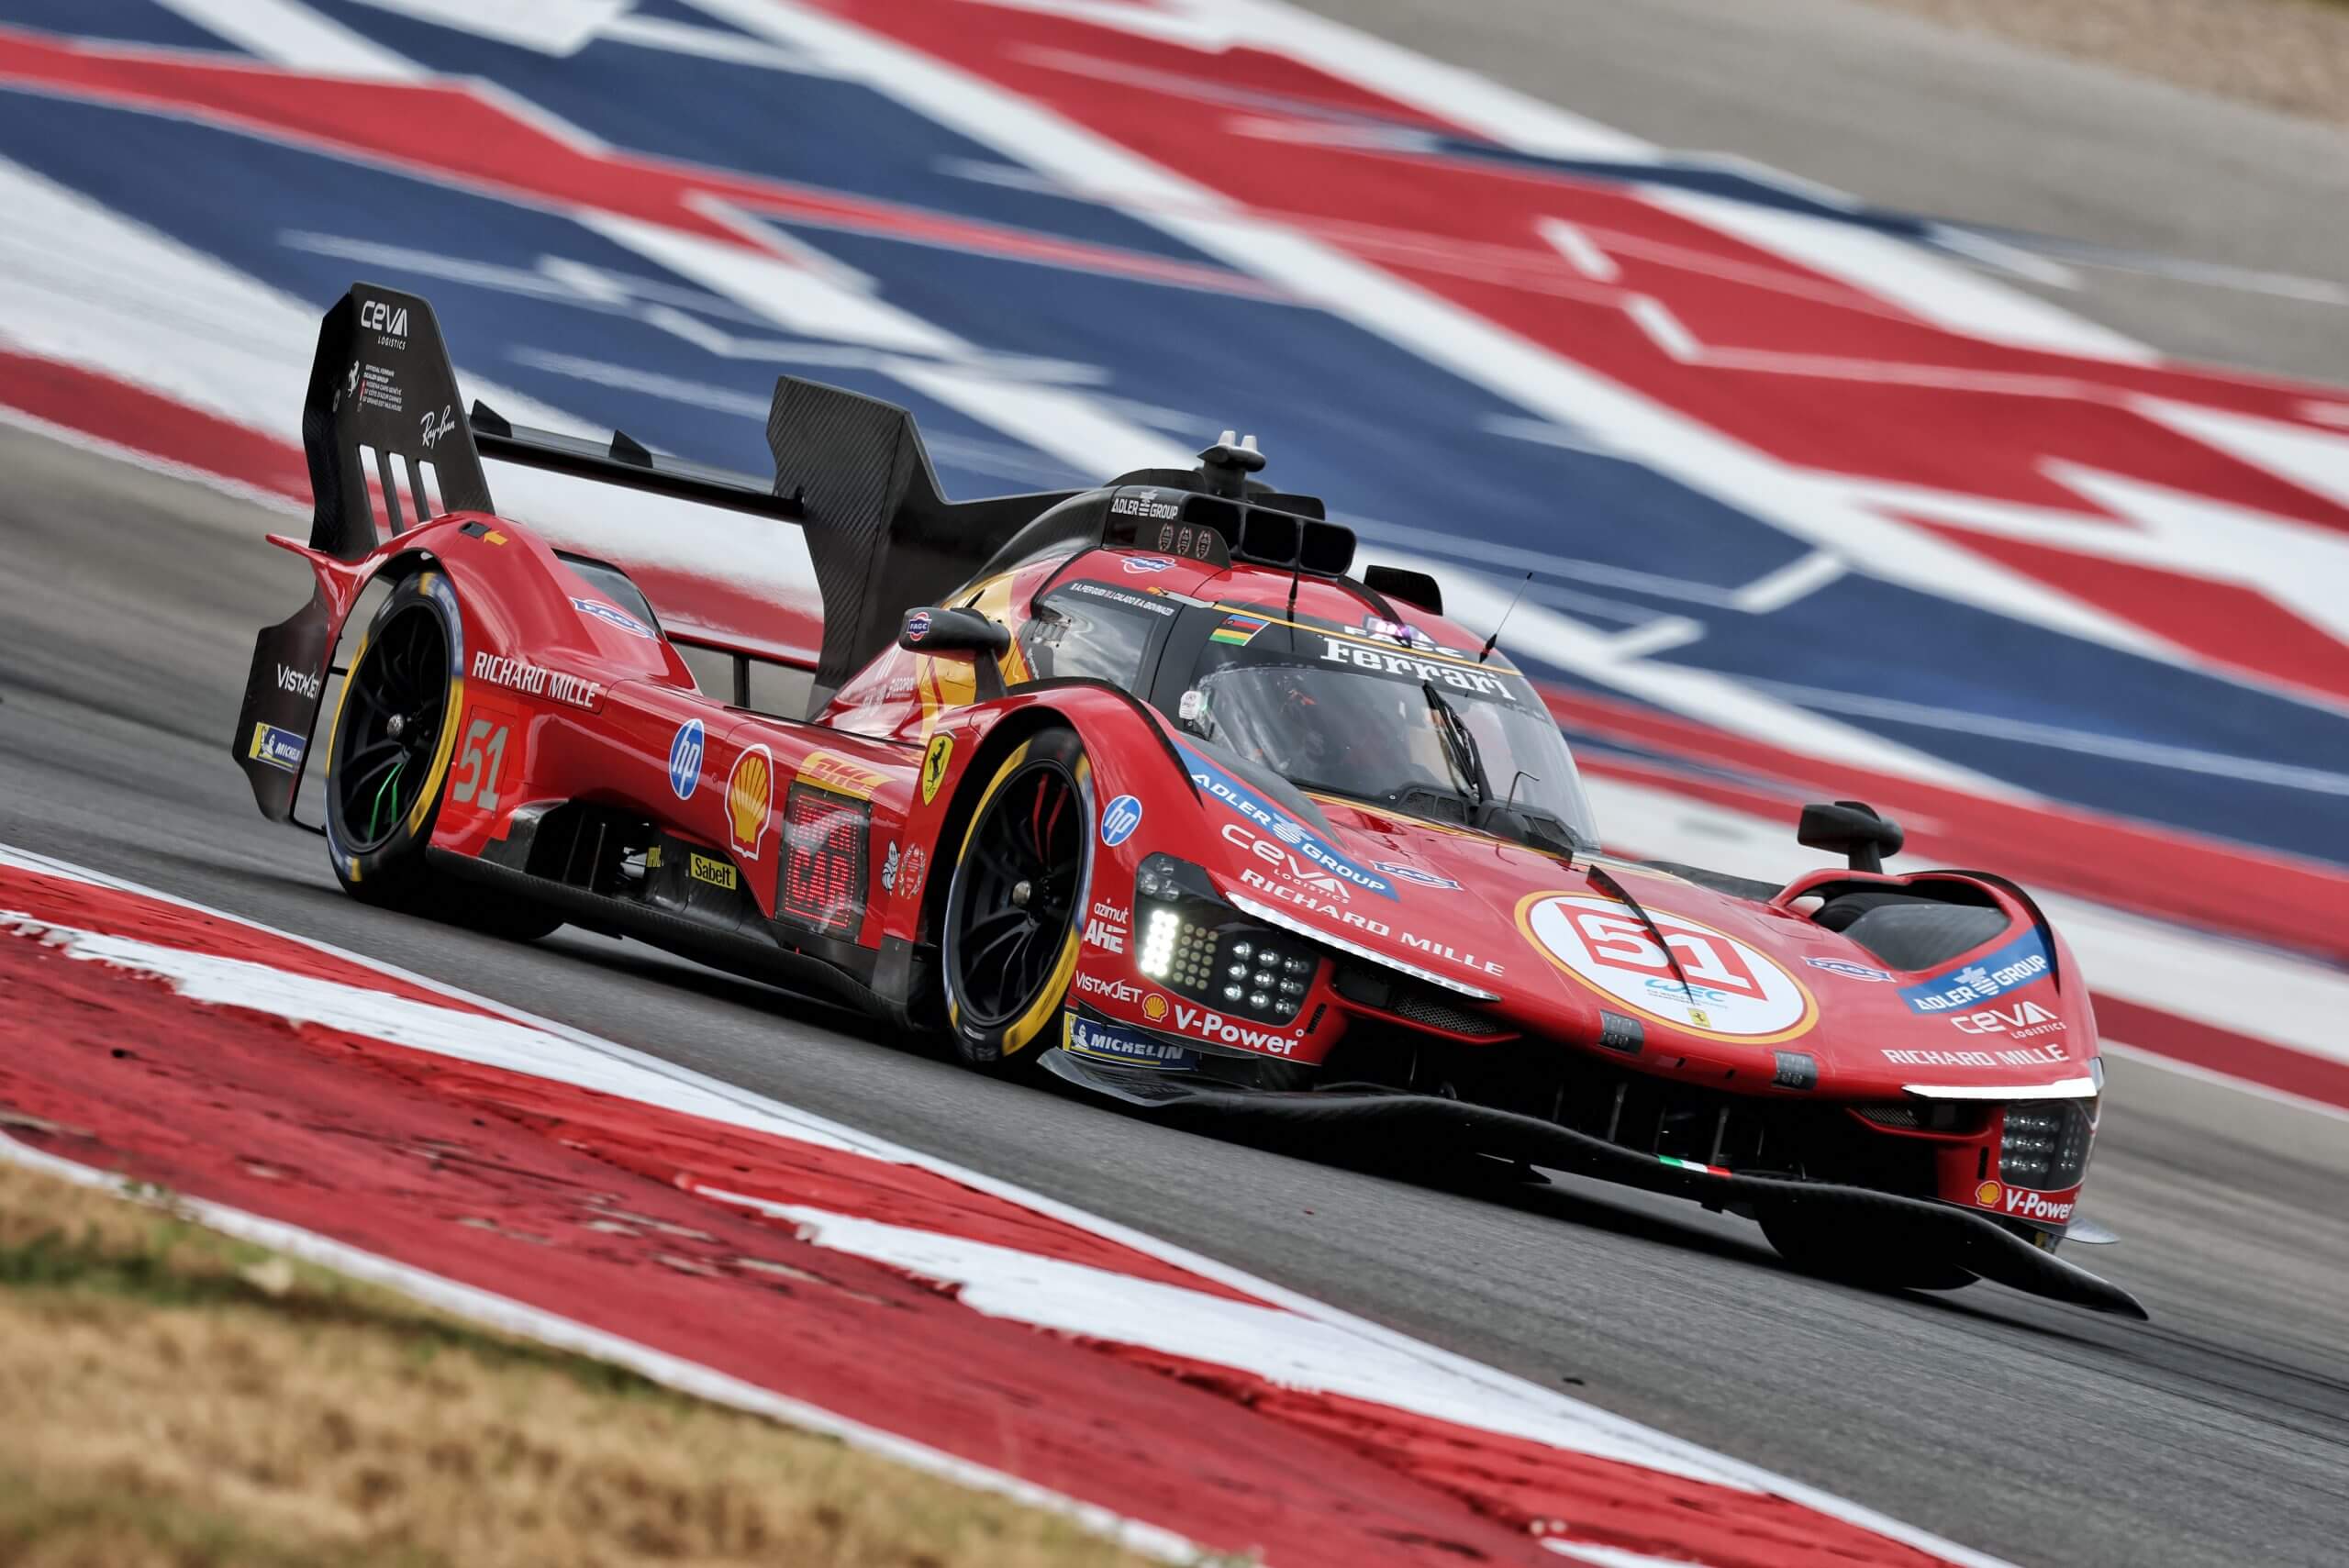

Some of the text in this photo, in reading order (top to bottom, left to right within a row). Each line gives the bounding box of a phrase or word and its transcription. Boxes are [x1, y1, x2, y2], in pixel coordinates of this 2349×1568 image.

[361, 300, 407, 337] CEVA
[377, 335, 406, 350] LOGISTICS
[420, 405, 455, 450] Ray-Ban
[1111, 497, 1178, 519] ADLER GROUP
[472, 651, 600, 708] RICHARD MILLE
[1320, 637, 1517, 701] Ferrari
[452, 718, 508, 811] 51
[673, 721, 700, 797] hp
[1104, 797, 1137, 843] hp
[1191, 773, 1387, 891] ADLER GROUP
[695, 857, 732, 886] Sabelt
[792, 844, 850, 915] CAR
[1221, 824, 1352, 898] CEVA
[1274, 868, 1350, 904] LOGISTICS
[1094, 897, 1130, 925] azimut
[1241, 868, 1505, 977] RICHARD MILLE
[1576, 913, 1753, 990] 51
[1644, 978, 1728, 1003] WEC
[1914, 954, 2048, 1010] ADLER GROUP
[1174, 1005, 1298, 1055] V-Power
[1950, 1000, 2058, 1034] CEVA
[2010, 1021, 2067, 1039] LOGISTICS
[1091, 1033, 1184, 1060] MICHELIN
[1880, 1043, 2070, 1066] RICHARD MILLE
[2006, 1188, 2074, 1219] V-Power
